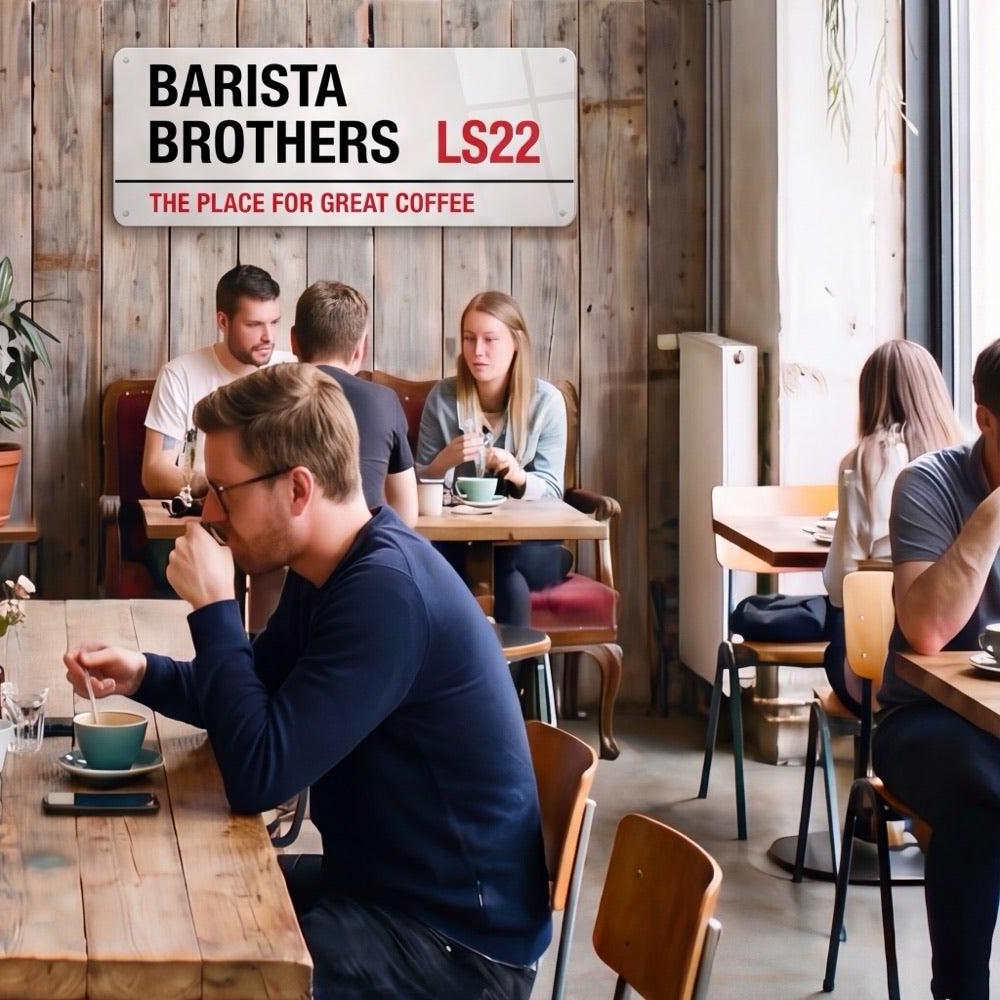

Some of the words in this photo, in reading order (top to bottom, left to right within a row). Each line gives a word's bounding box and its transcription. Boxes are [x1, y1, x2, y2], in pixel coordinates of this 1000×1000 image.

[149, 63, 347, 108] BARISTA
[149, 119, 400, 164] BROTHERS
[437, 119, 541, 165] LS22
[149, 192, 190, 213] THE
[197, 192, 265, 213] PLACE
[272, 192, 313, 213] FOR
[320, 192, 389, 213] GREAT
[395, 191, 475, 214] COFFEE
